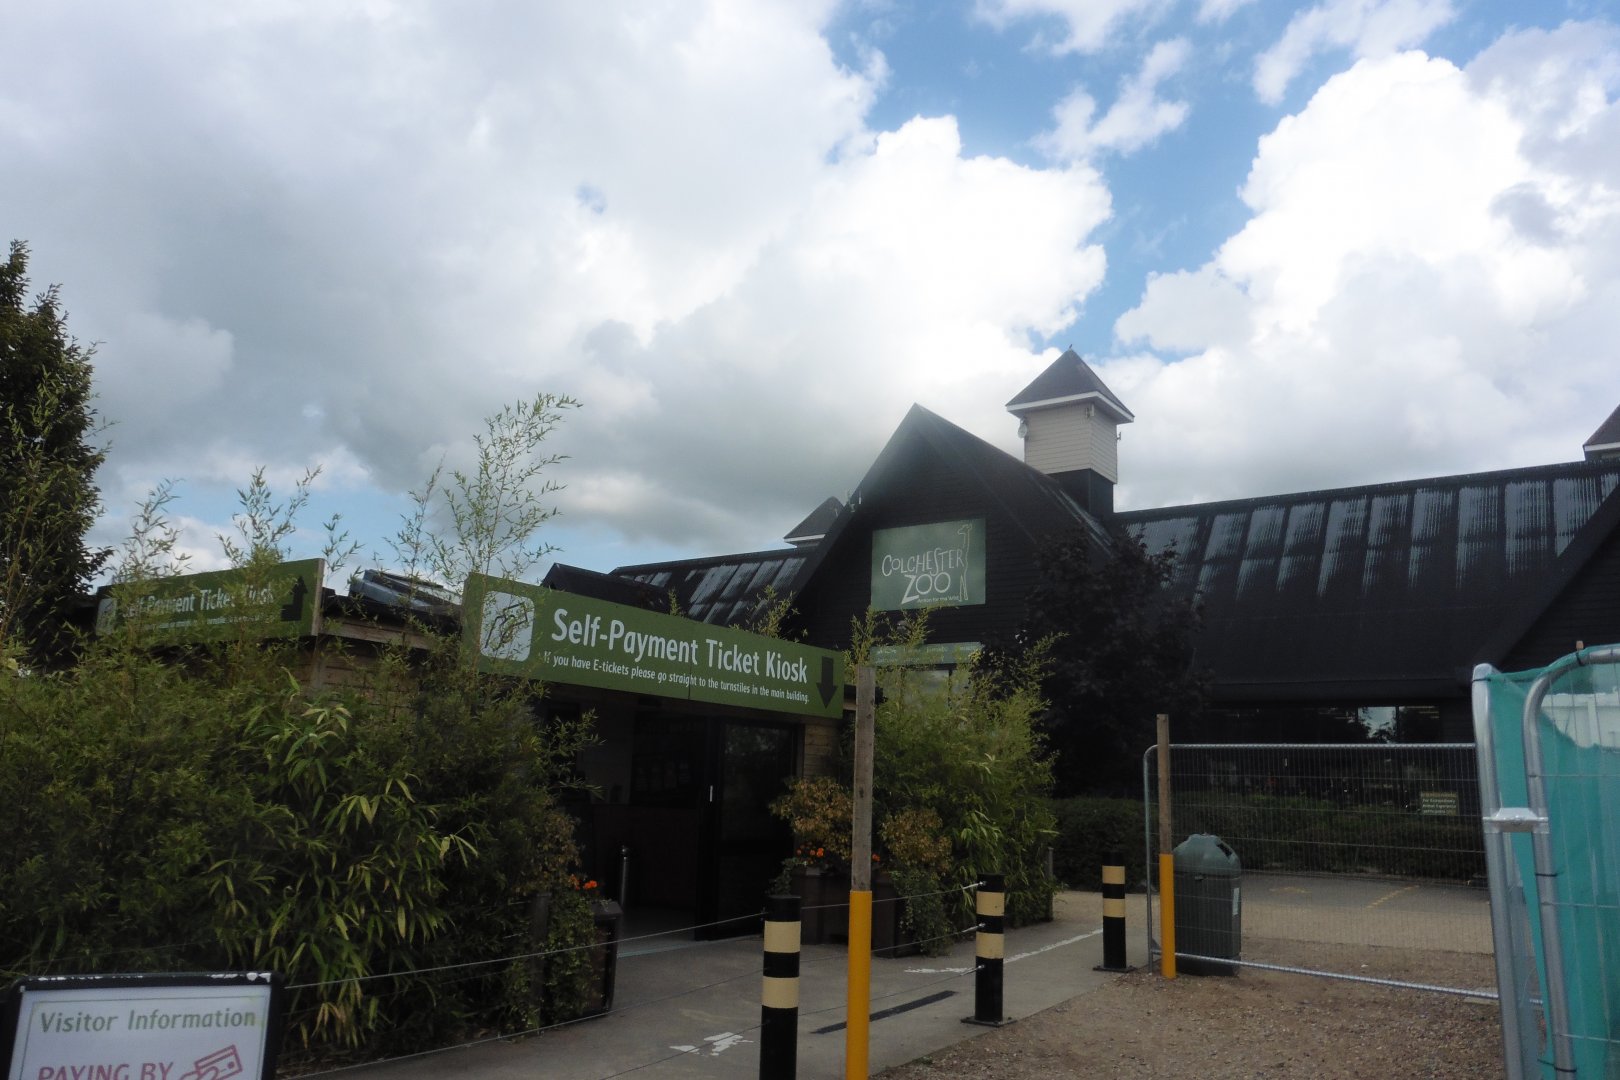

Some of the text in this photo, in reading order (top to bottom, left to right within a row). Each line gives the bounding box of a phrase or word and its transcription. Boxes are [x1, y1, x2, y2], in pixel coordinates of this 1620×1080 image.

[882, 547, 964, 577] COLCHESTER
[901, 571, 951, 605] ZOO
[551, 608, 807, 683] Self-Payment Ticket Kiosk
[553, 655, 569, 667] you
[571, 656, 591, 669] have
[593, 659, 629, 675] E-tickets
[631, 666, 656, 679] please
[657, 672, 667, 683] go
[669, 672, 697, 687] straight
[699, 678, 706, 687] to
[708, 678, 719, 689] the
[720, 680, 750, 694] turnstiles
[752, 685, 758, 694] in
[760, 686, 770, 695] the
[770, 688, 785, 698] main
[786, 689, 810, 704] building.
[41, 1008, 256, 1033] Visitor Information
[37, 1061, 174, 1080] PAYING BY
